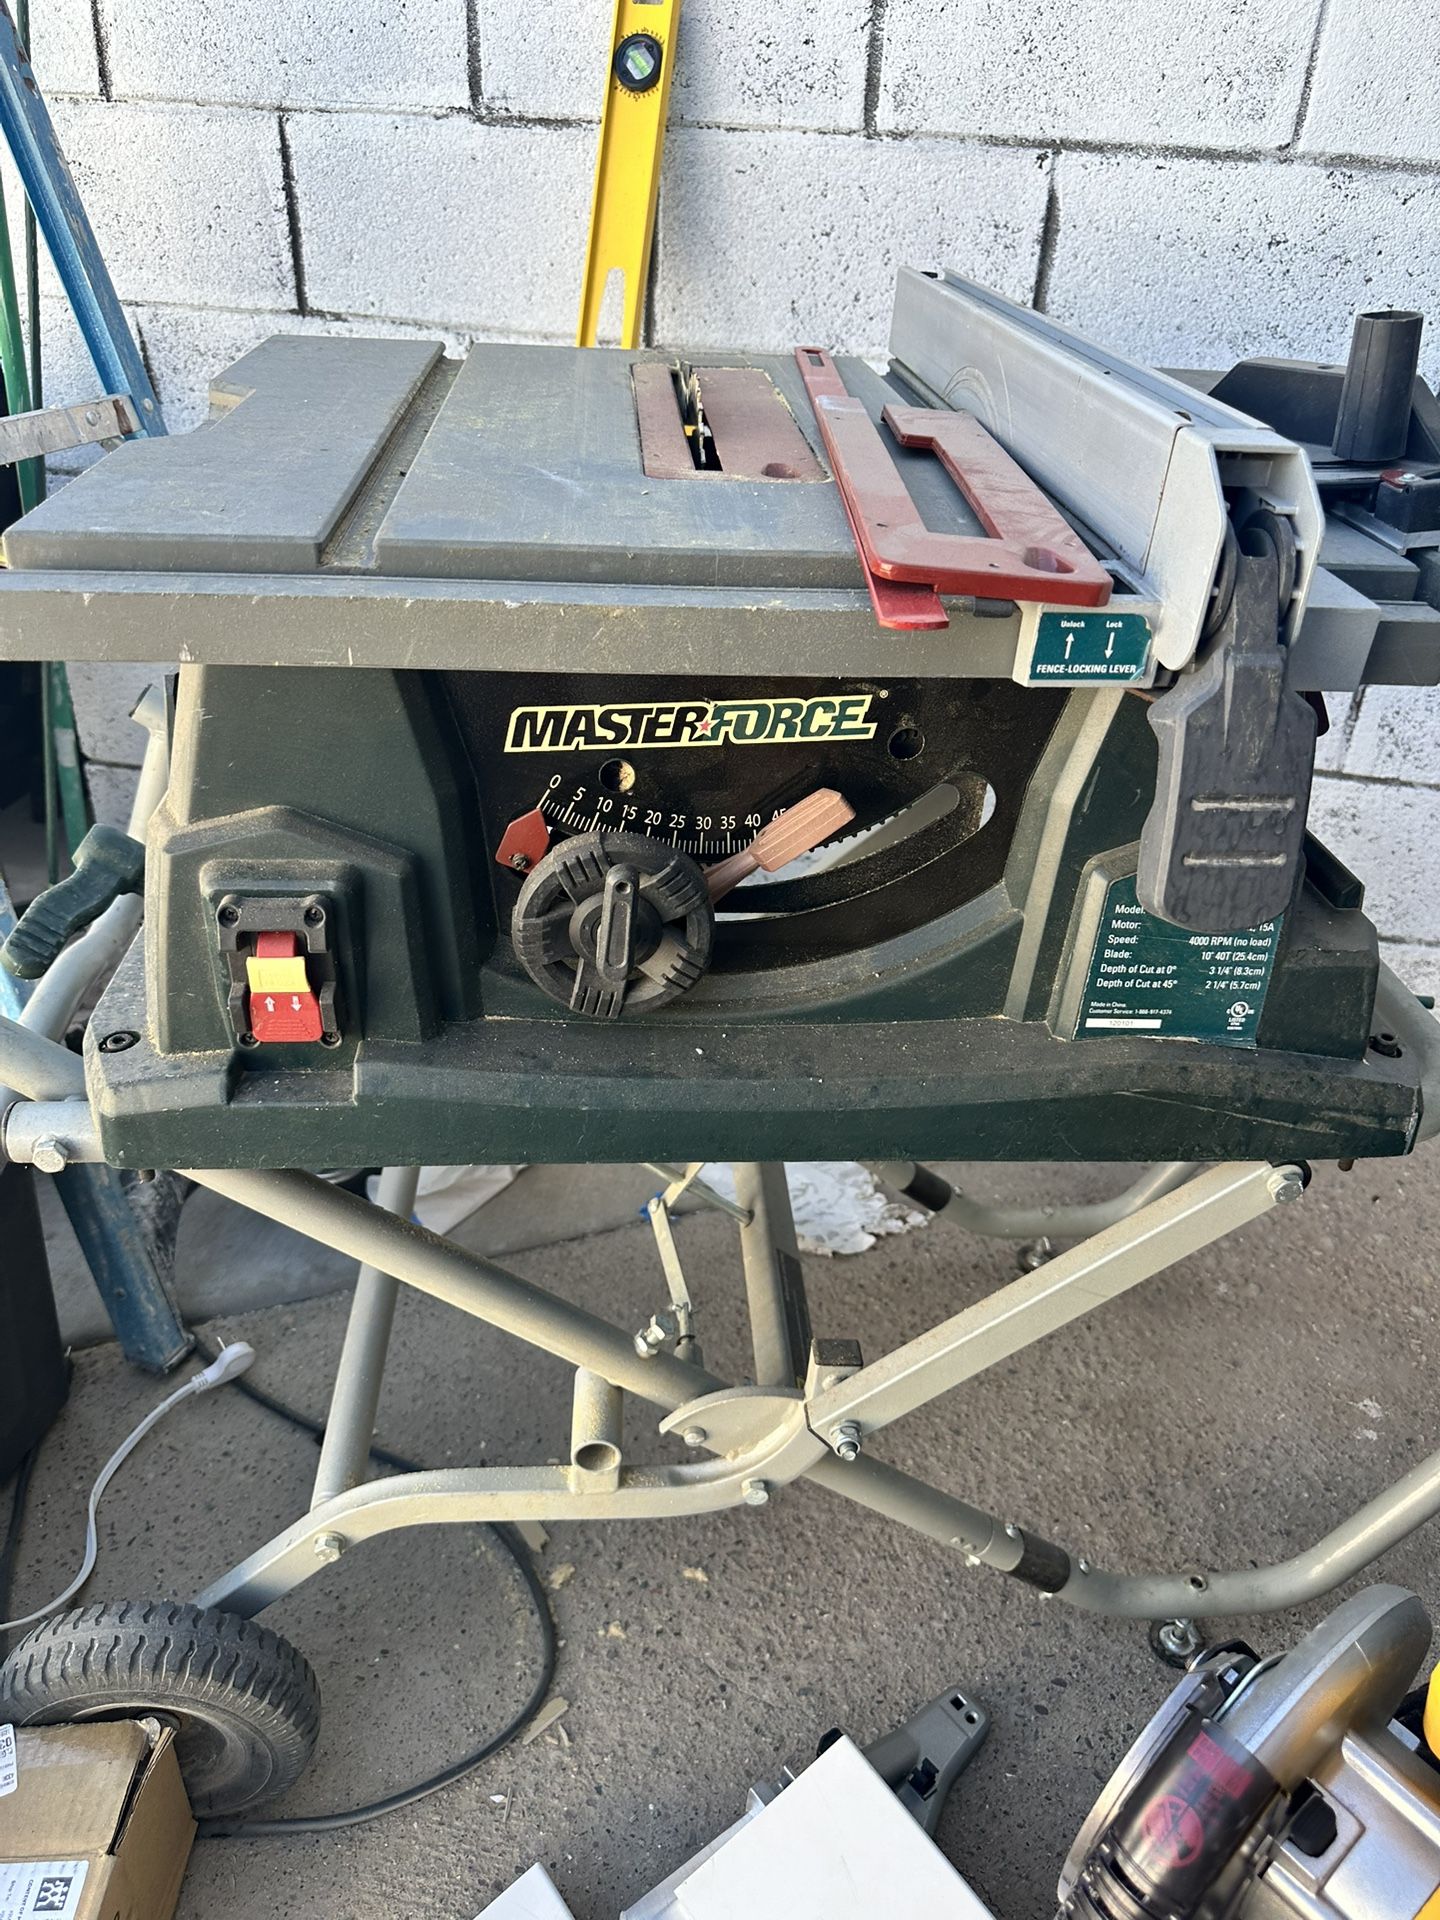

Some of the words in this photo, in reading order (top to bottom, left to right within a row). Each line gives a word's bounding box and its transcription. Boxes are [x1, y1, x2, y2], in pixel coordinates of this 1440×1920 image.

[1060, 620, 1085, 628] Unlock
[1105, 620, 1123, 628] Lock
[1036, 664, 1107, 673] FENCE-LOCKING
[1108, 665, 1137, 673] LEVER
[549, 774, 562, 789] 0
[572, 786, 587, 801] 5
[596, 796, 613, 813] 10
[622, 804, 638, 820] 15
[644, 810, 662, 825] 20
[668, 813, 686, 828] 25
[695, 816, 712, 830] 30
[720, 815, 736, 830] 35
[744, 813, 761, 827] 40
[1107, 935, 1139, 945] Speed:
[1189, 936, 1210, 946] 4000
[1210, 937, 1233, 946] RPM
[1234, 938, 1248, 947] (no
[1249, 938, 1272, 948] load)
[1104, 949, 1133, 959] Blade:
[1215, 952, 1232, 961] 40T
[1232, 952, 1268, 962] (25.4cm)
[1100, 964, 1127, 974] Depth
[1128, 964, 1138, 973] of
[1139, 965, 1155, 974] Cut
[1155, 965, 1165, 974] at
[1208, 966, 1216, 975] 3
[1233, 967, 1265, 977] (8.3cm)
[1096, 979, 1123, 989] Depth
[1124, 979, 1135, 988] of
[1135, 979, 1151, 988] Cut
[1152, 980, 1162, 988] at
[1204, 980, 1212, 989] 2
[1229, 981, 1262, 991] (5.7cm)
